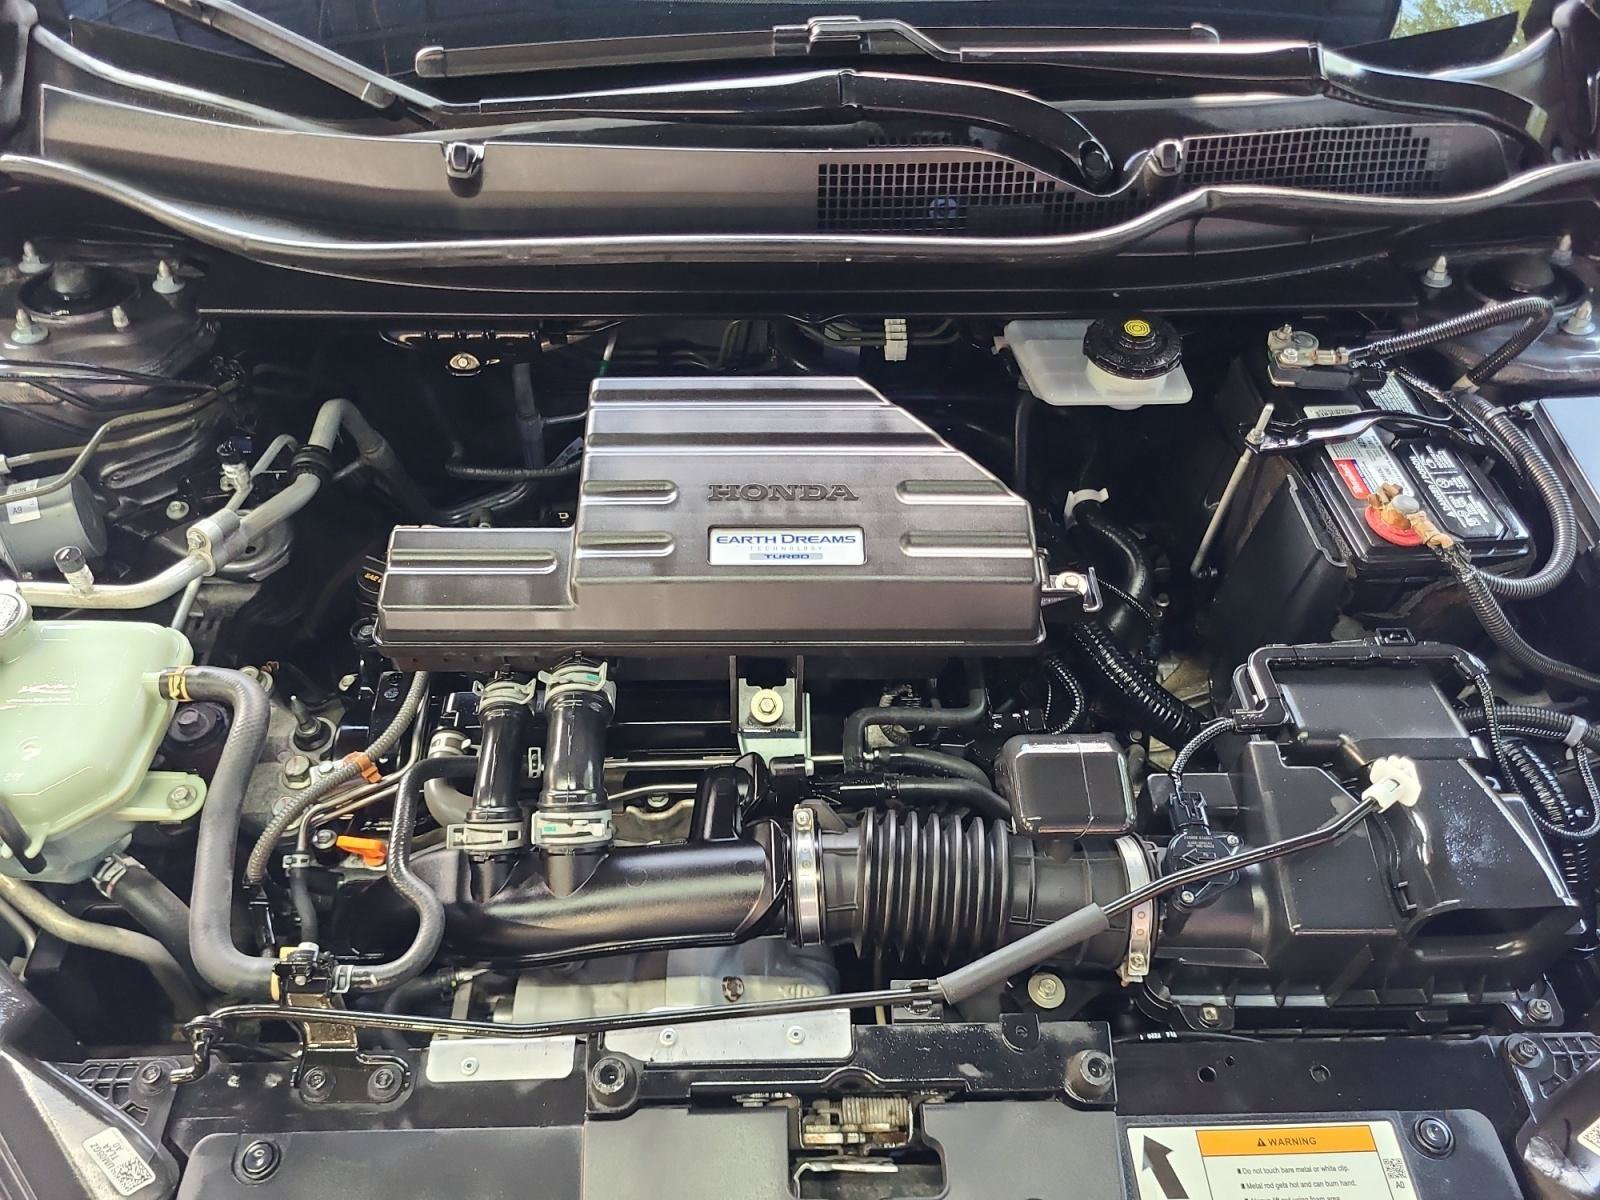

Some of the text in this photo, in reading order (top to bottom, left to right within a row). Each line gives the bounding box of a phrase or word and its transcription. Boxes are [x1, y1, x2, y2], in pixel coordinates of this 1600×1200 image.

[708, 483, 859, 502] HONDA
[716, 534, 856, 544] EARTH DREAMS
[1267, 1136, 1317, 1148] WARNING
[1275, 1182, 1288, 1191] gets
